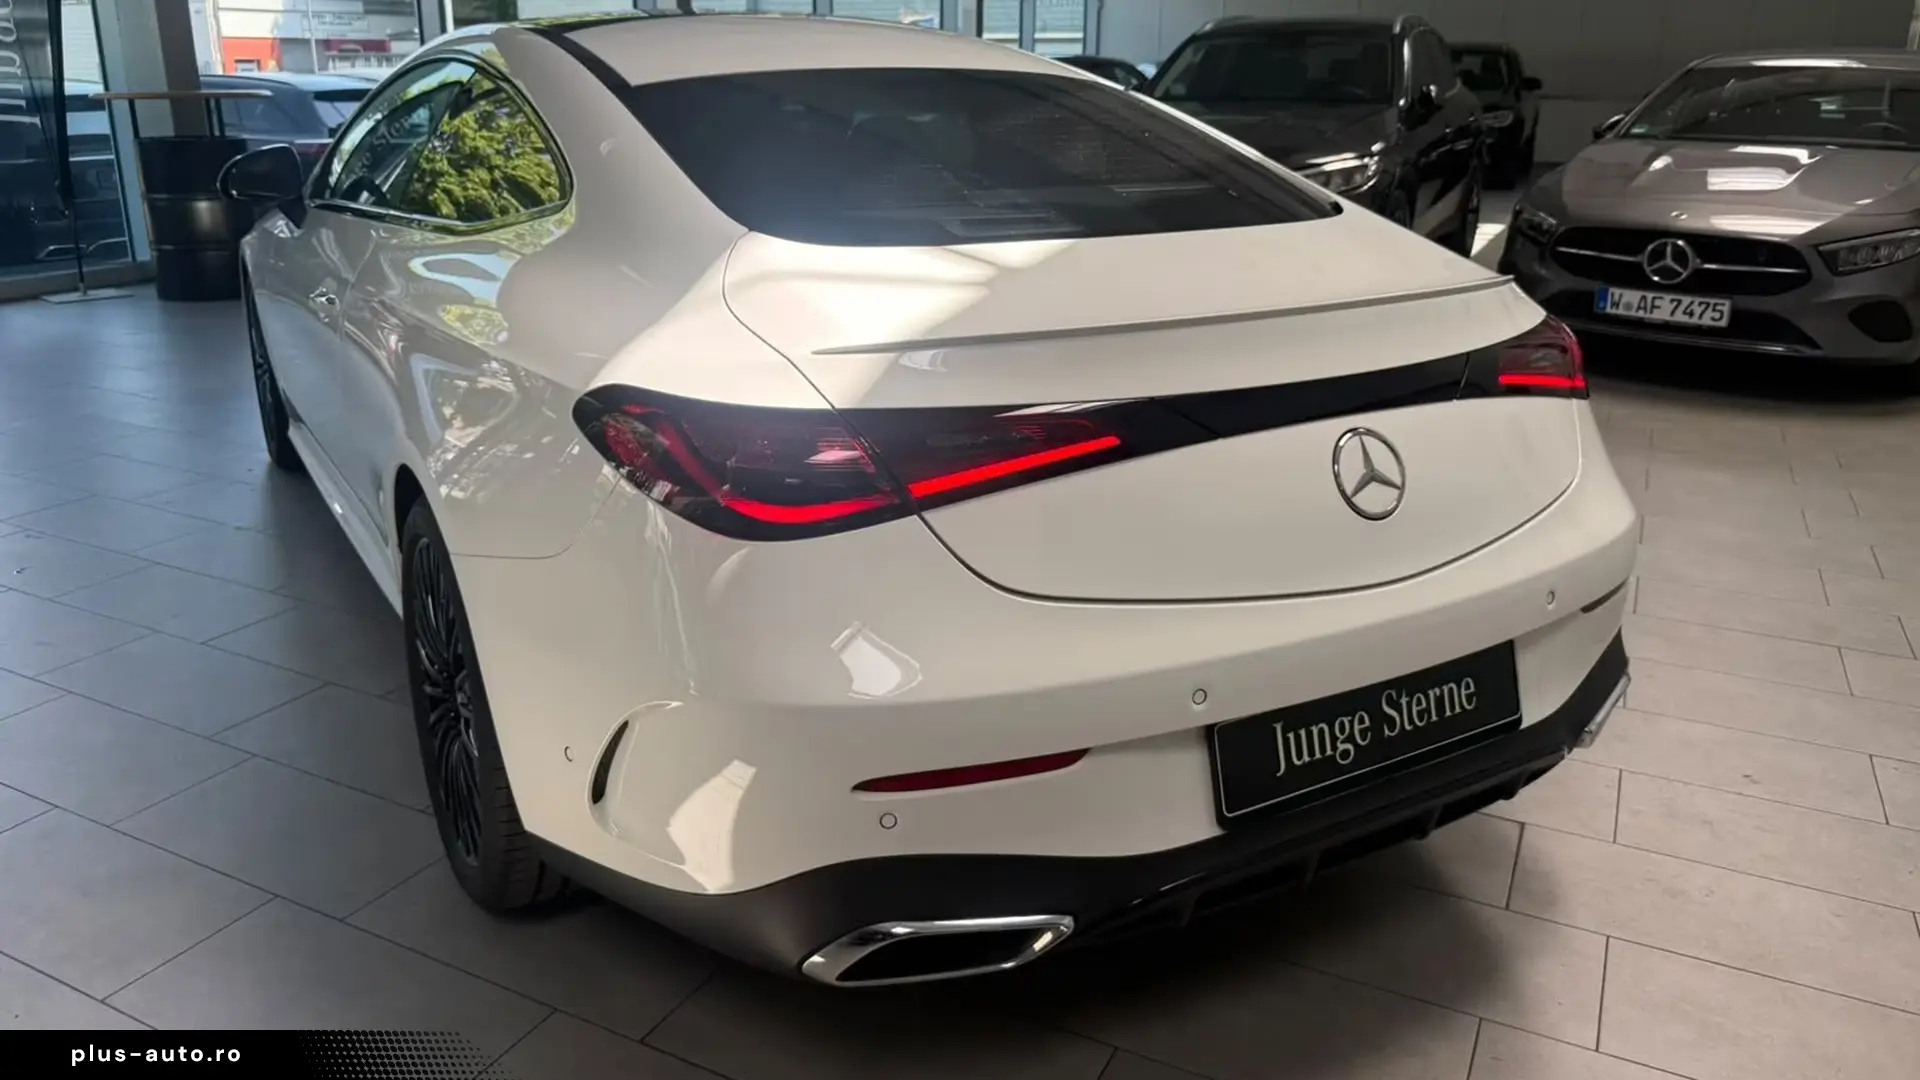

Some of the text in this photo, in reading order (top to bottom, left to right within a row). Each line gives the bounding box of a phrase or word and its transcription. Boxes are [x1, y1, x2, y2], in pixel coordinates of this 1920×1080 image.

[1610, 292, 1726, 322] W AF 7475
[1273, 676, 1476, 777] Junge Sterne
